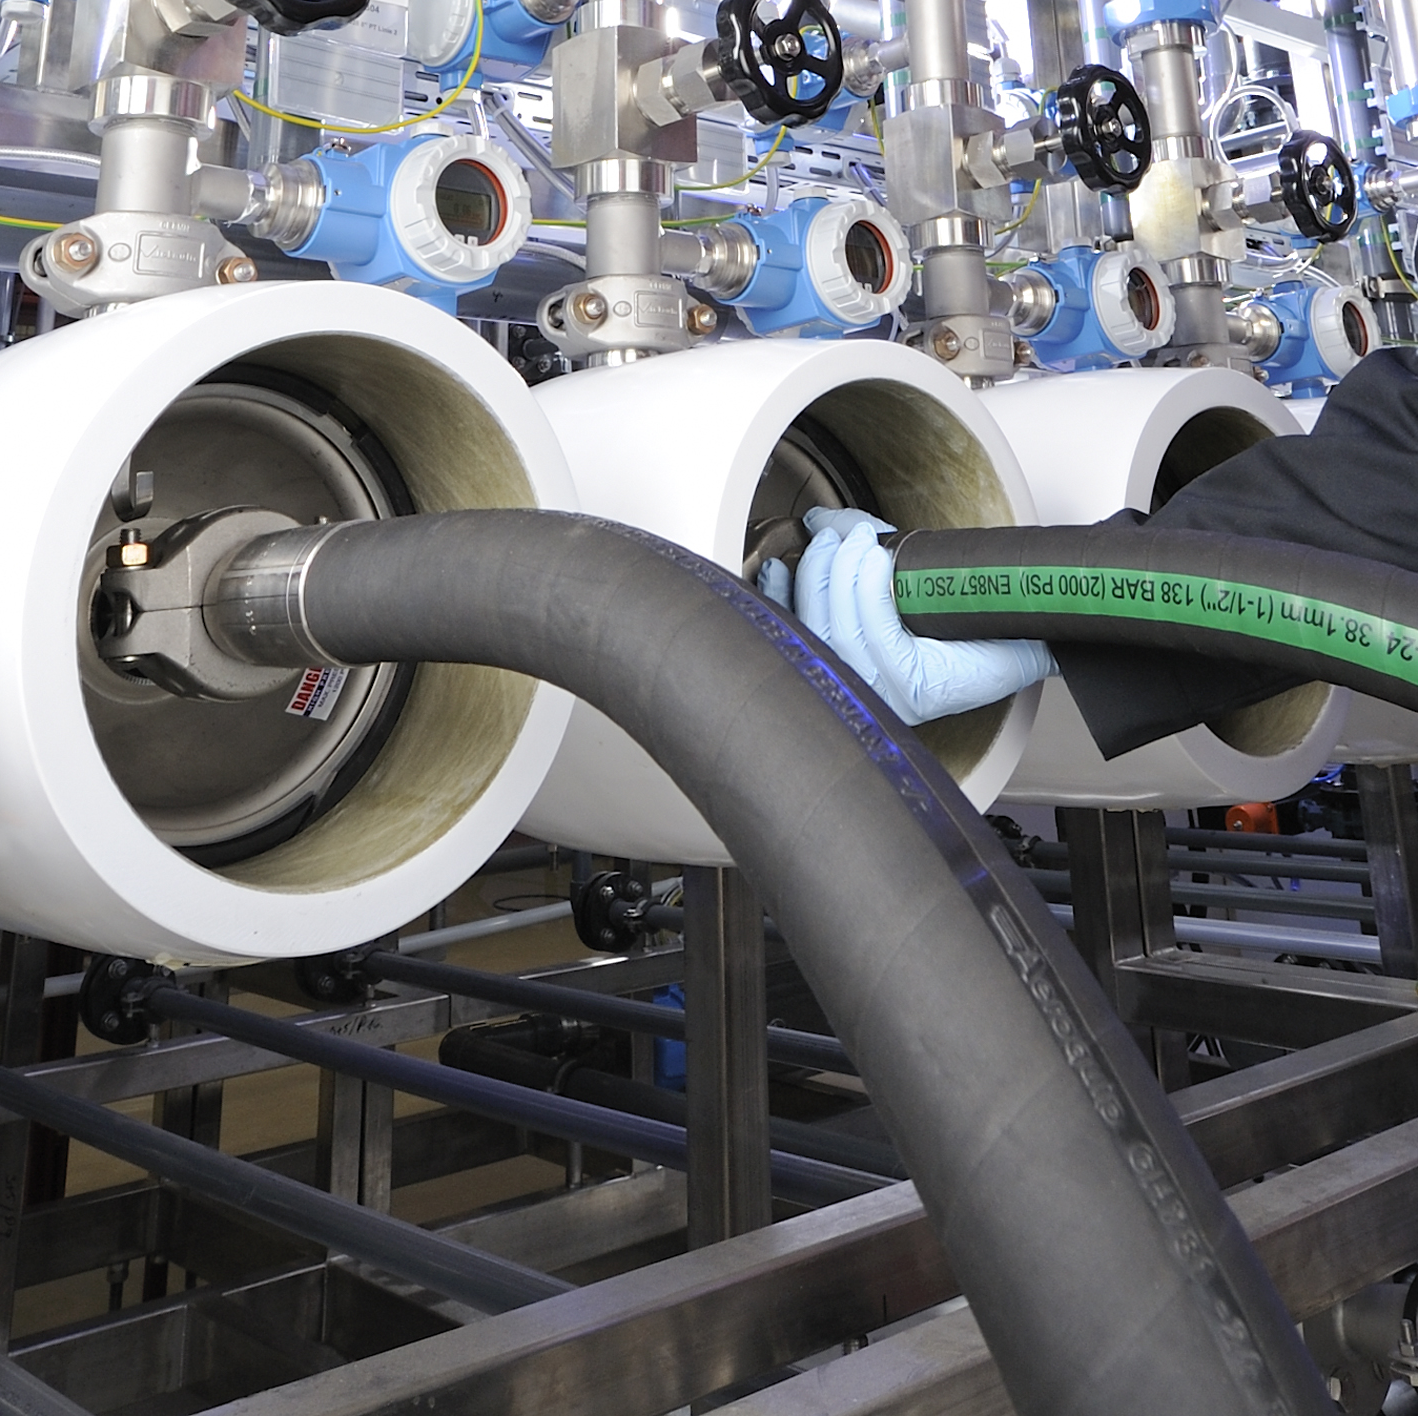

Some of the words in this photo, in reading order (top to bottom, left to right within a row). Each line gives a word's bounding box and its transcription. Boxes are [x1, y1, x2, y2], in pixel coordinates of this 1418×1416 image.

[924, 576, 957, 598] 2SC
[959, 574, 1011, 598] EN857
[1019, 572, 1055, 598] PSI)
[1058, 573, 1106, 601] (2000
[1110, 576, 1156, 604] BAR
[1160, 580, 1195, 606] 138
[1280, 600, 1374, 649] 38.1mm
